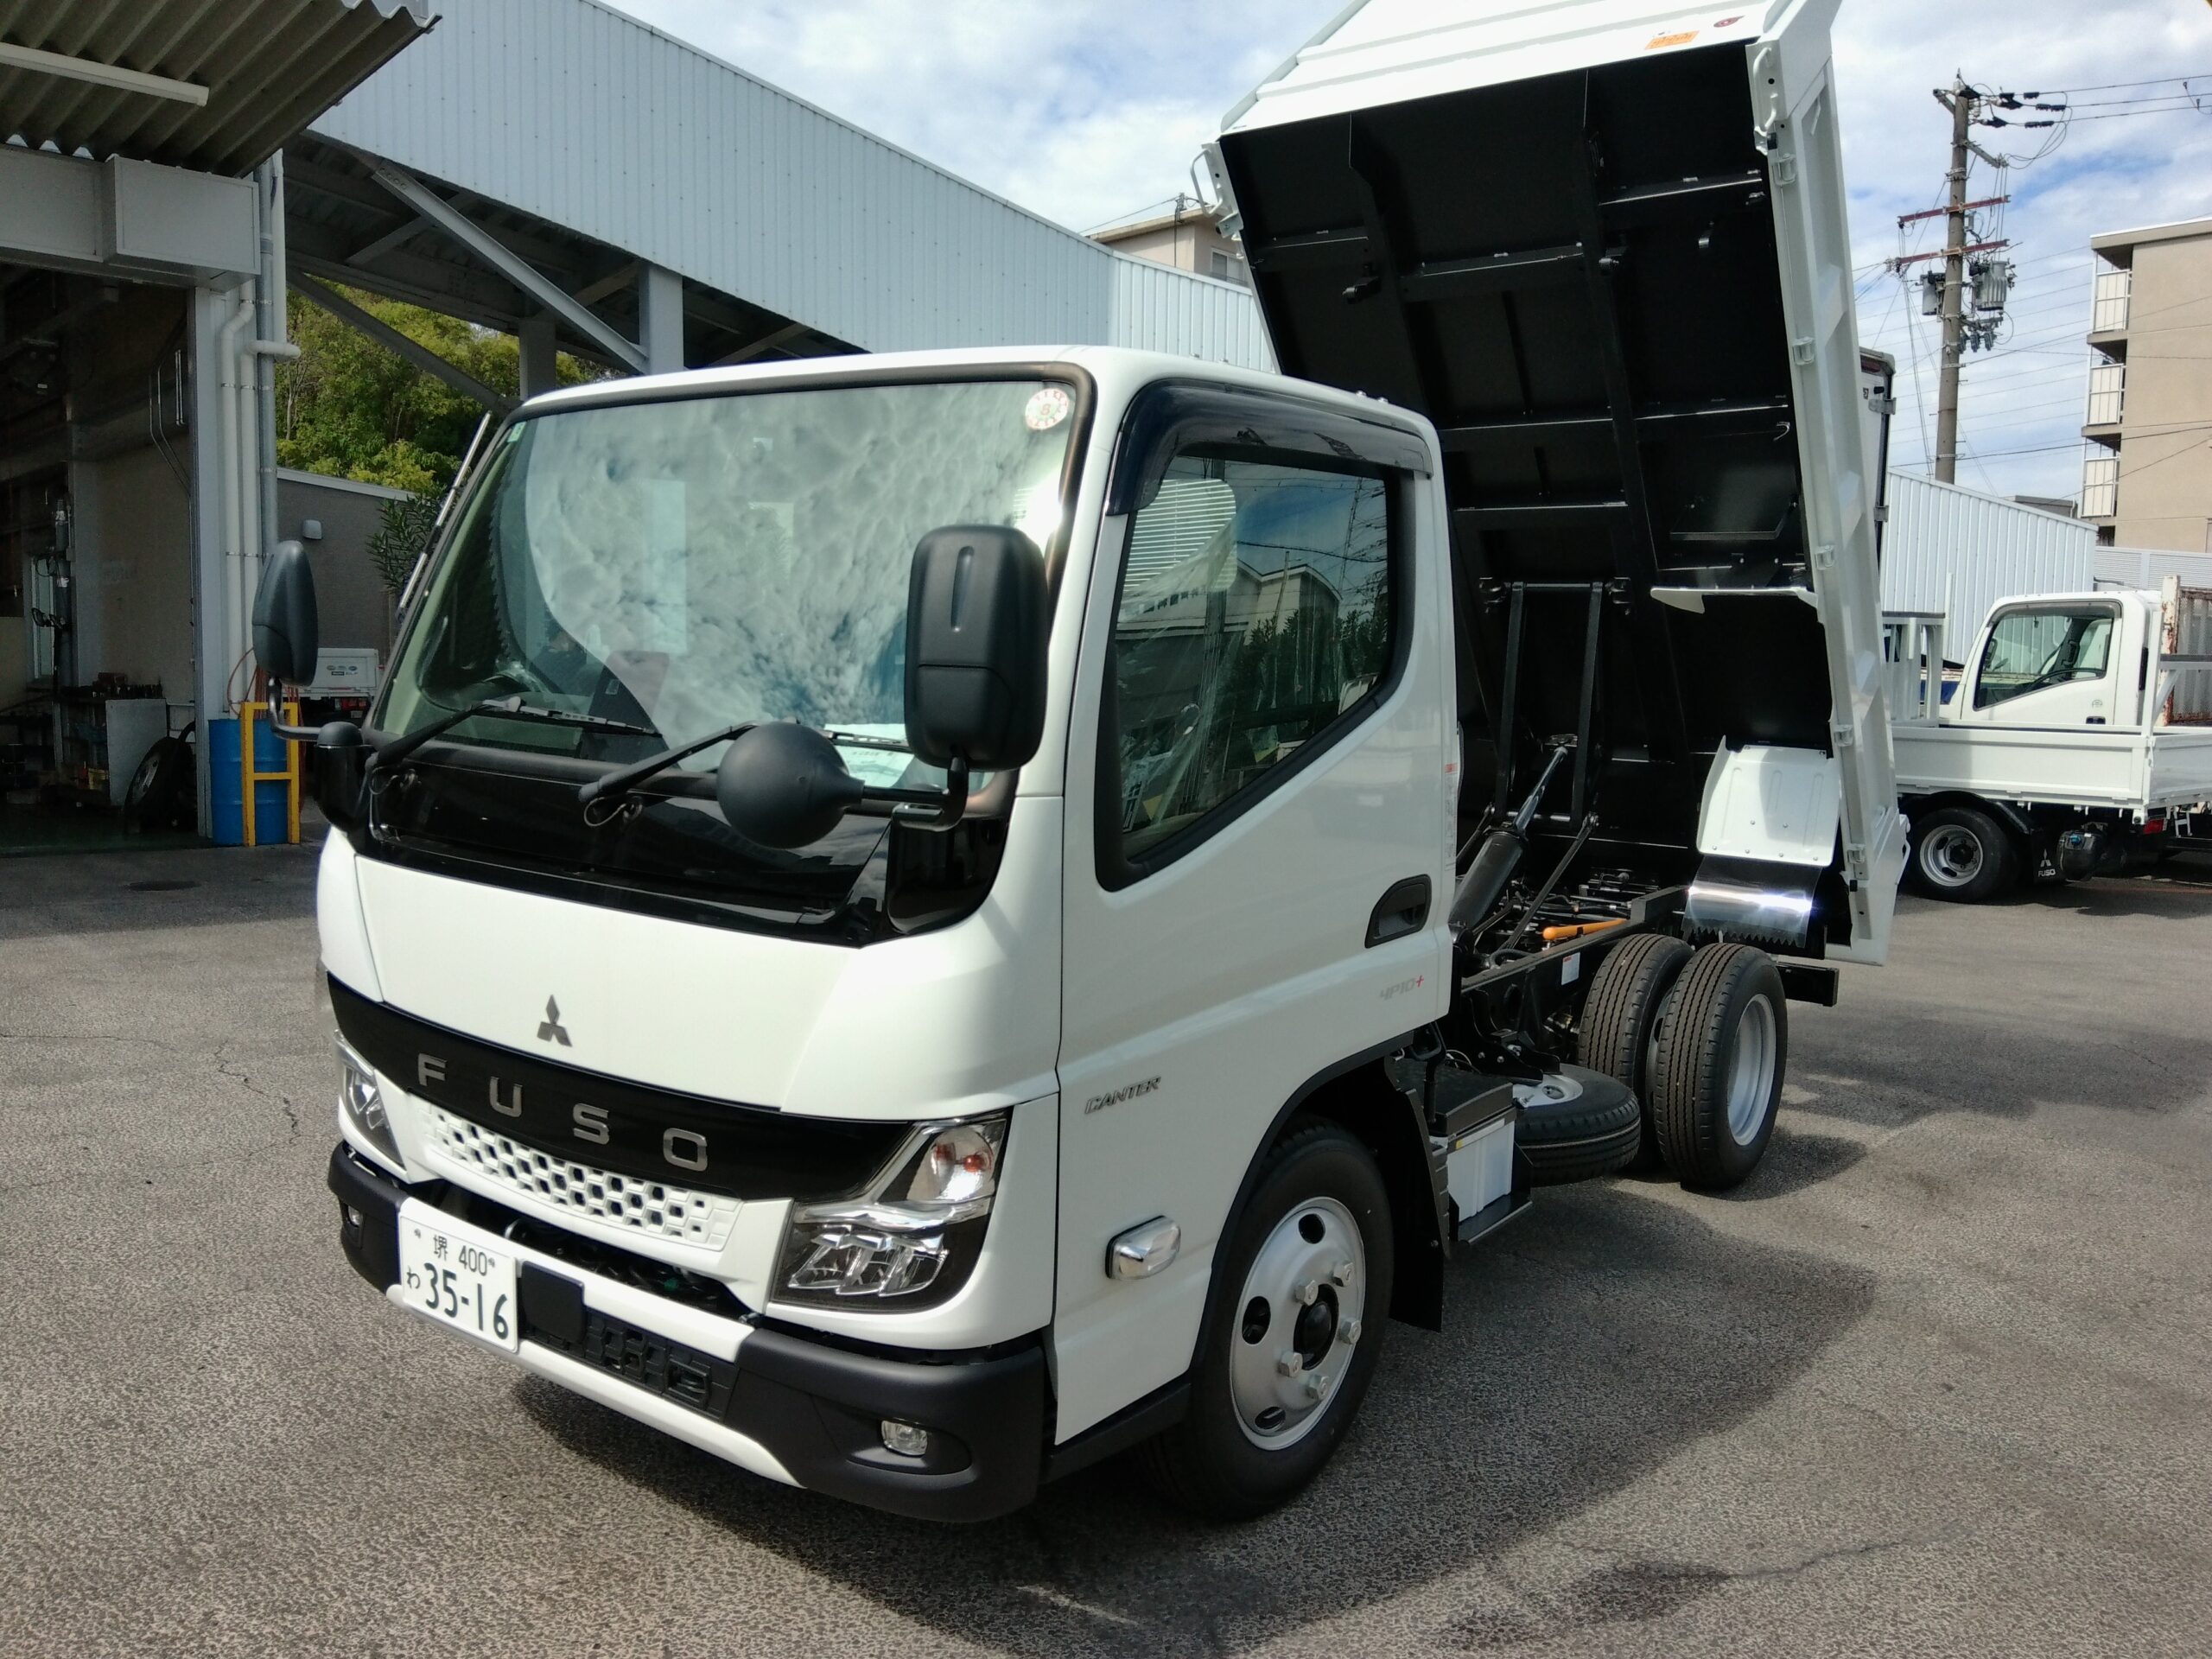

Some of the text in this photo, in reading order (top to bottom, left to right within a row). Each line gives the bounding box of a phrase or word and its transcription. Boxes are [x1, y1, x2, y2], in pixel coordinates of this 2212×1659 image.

[2037, 868, 2056, 877] FUSO
[417, 1052, 709, 1172] FUSO
[1084, 1076, 1162, 1115] CANTER
[433, 1234, 487, 1277] 堺 400
[406, 1262, 509, 1340] わ 35-16
